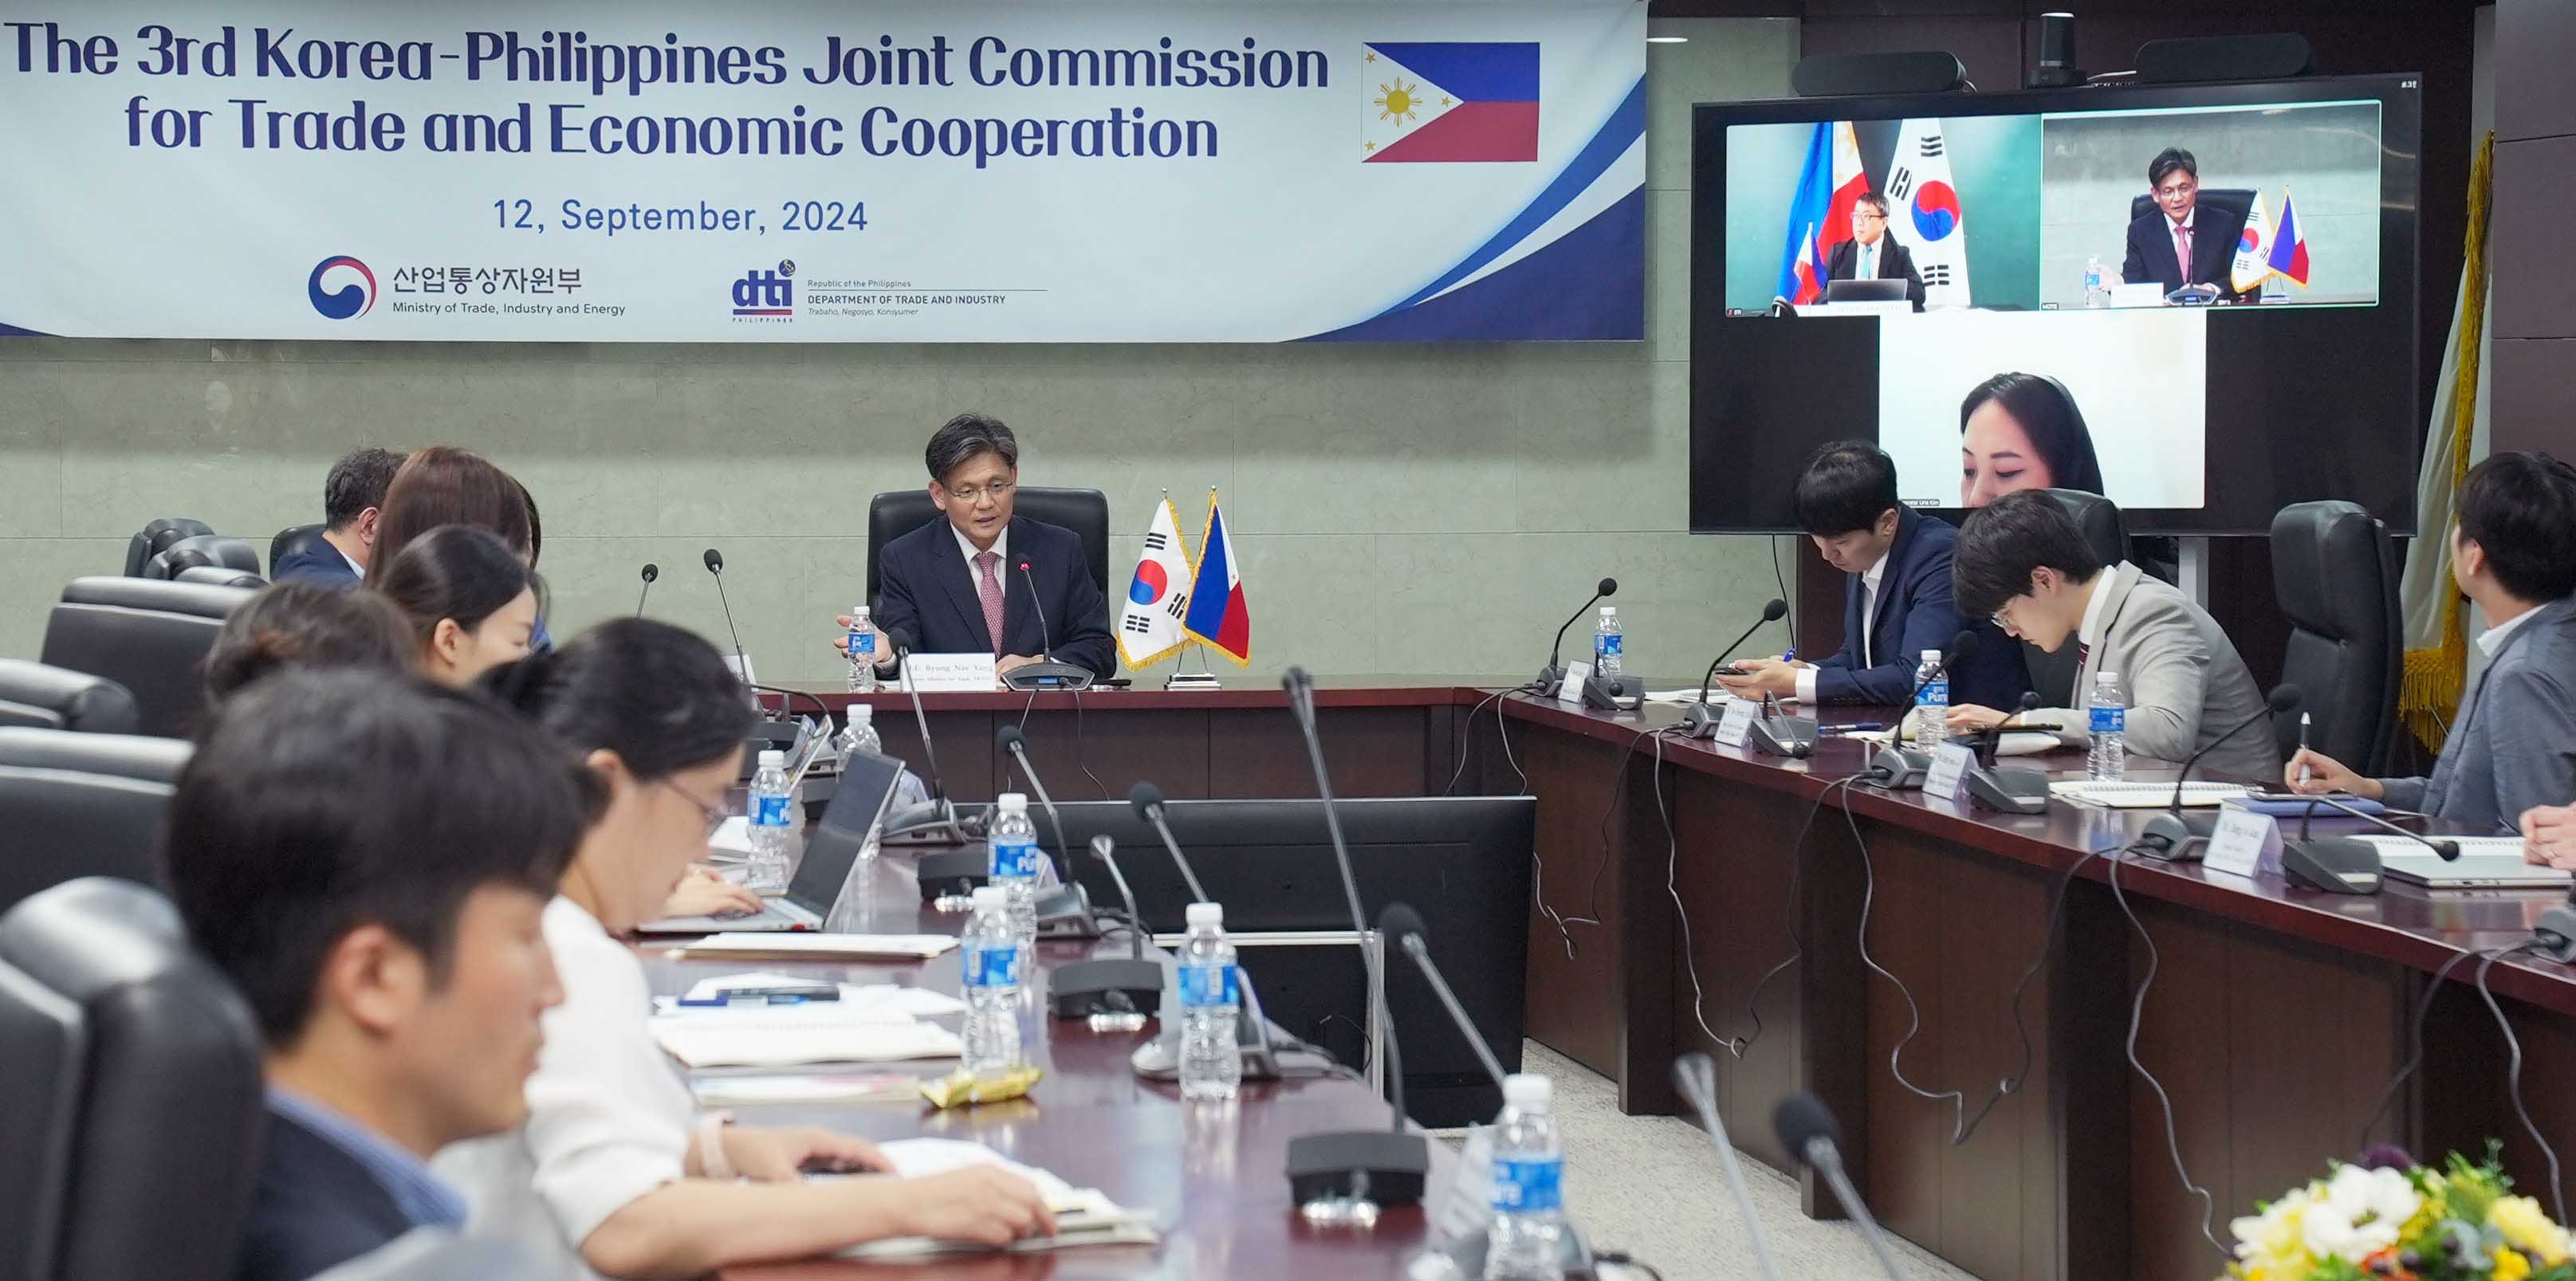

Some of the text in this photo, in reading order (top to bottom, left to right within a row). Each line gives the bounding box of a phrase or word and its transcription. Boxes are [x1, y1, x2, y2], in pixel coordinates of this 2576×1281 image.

[3, 22, 1327, 96] The 3rd Korea-Philippines Joint Commission
[124, 96, 1217, 169] for Trade and Economic Cooperation
[494, 199, 867, 236] 12, September, 2024
[394, 267, 581, 294] 산업통상자원부
[733, 259, 796, 307] dti
[808, 280, 842, 289] Republic
[394, 302, 626, 316] Ministry of Trade, Industry and Energy
